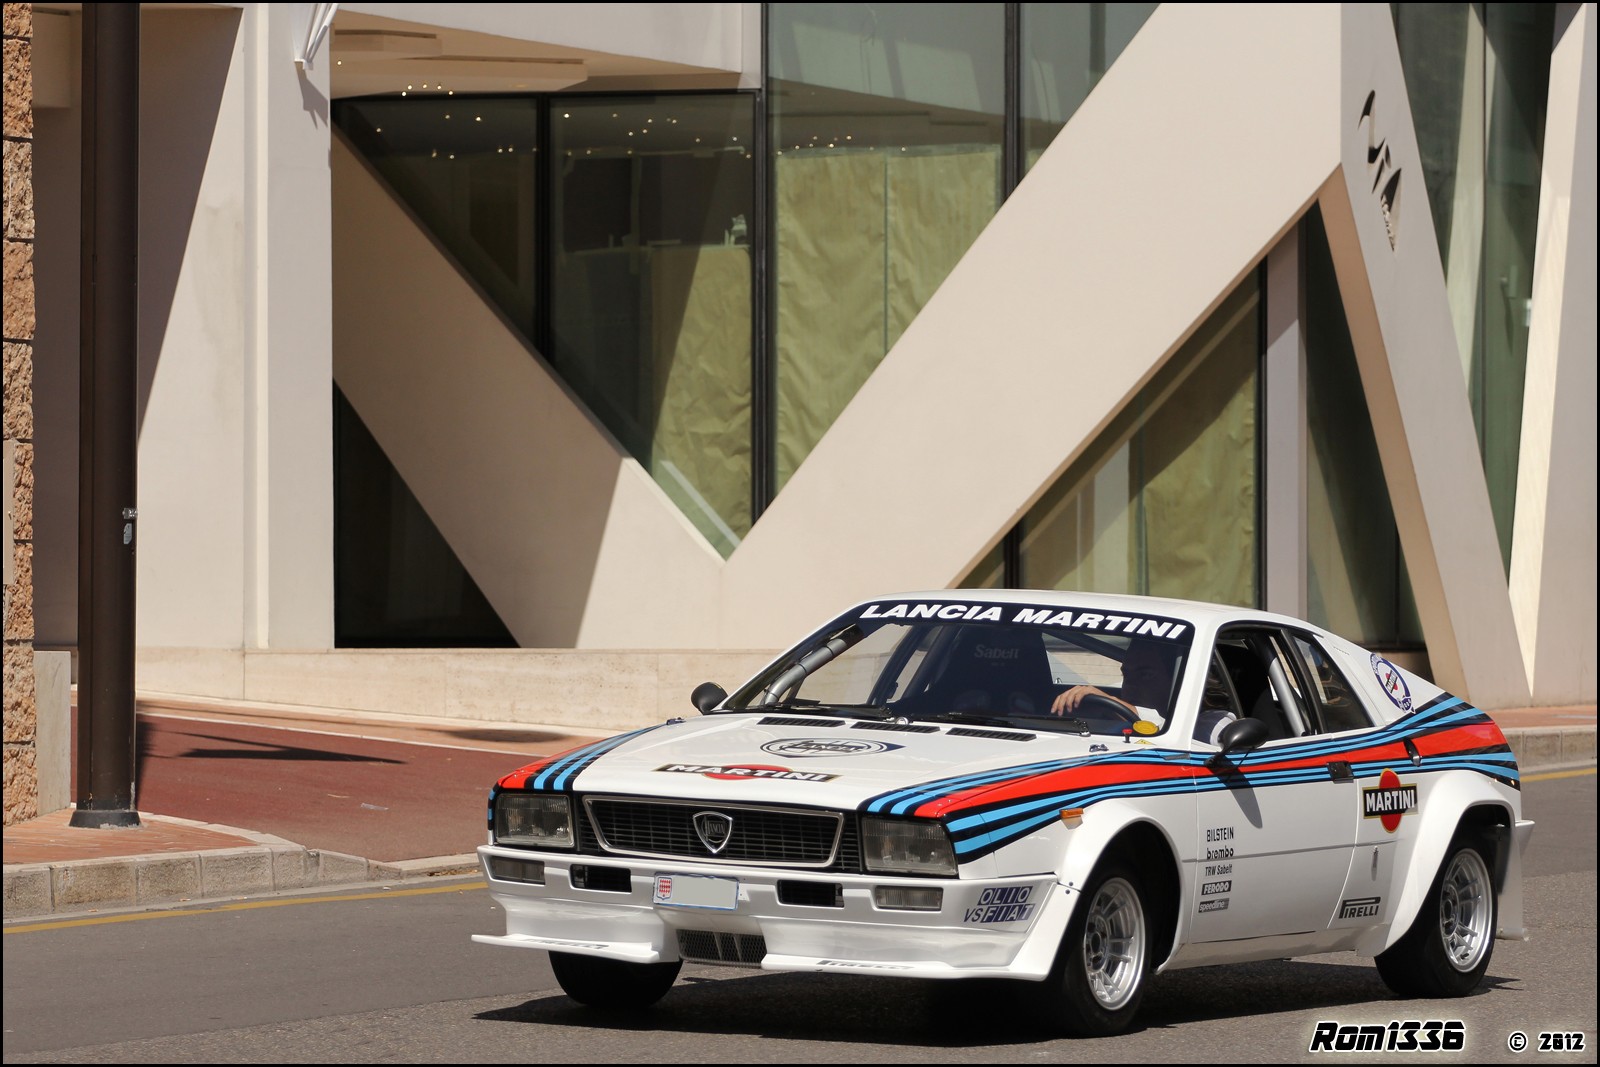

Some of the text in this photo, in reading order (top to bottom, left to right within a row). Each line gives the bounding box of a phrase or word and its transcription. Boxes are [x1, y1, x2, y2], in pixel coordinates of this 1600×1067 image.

[859, 603, 1187, 639] LANCIA MARTINI
[666, 764, 829, 781] MARTINI
[1365, 789, 1415, 813] MARTINI
[1206, 826, 1234, 842] BILSTEIN
[1206, 845, 1234, 860] brembo
[1205, 866, 1217, 876] TRW
[979, 887, 1031, 905] OLIO
[1203, 882, 1230, 895] FERODO
[963, 904, 1034, 923] VS FIAT
[1338, 896, 1381, 919] PIRELLI
